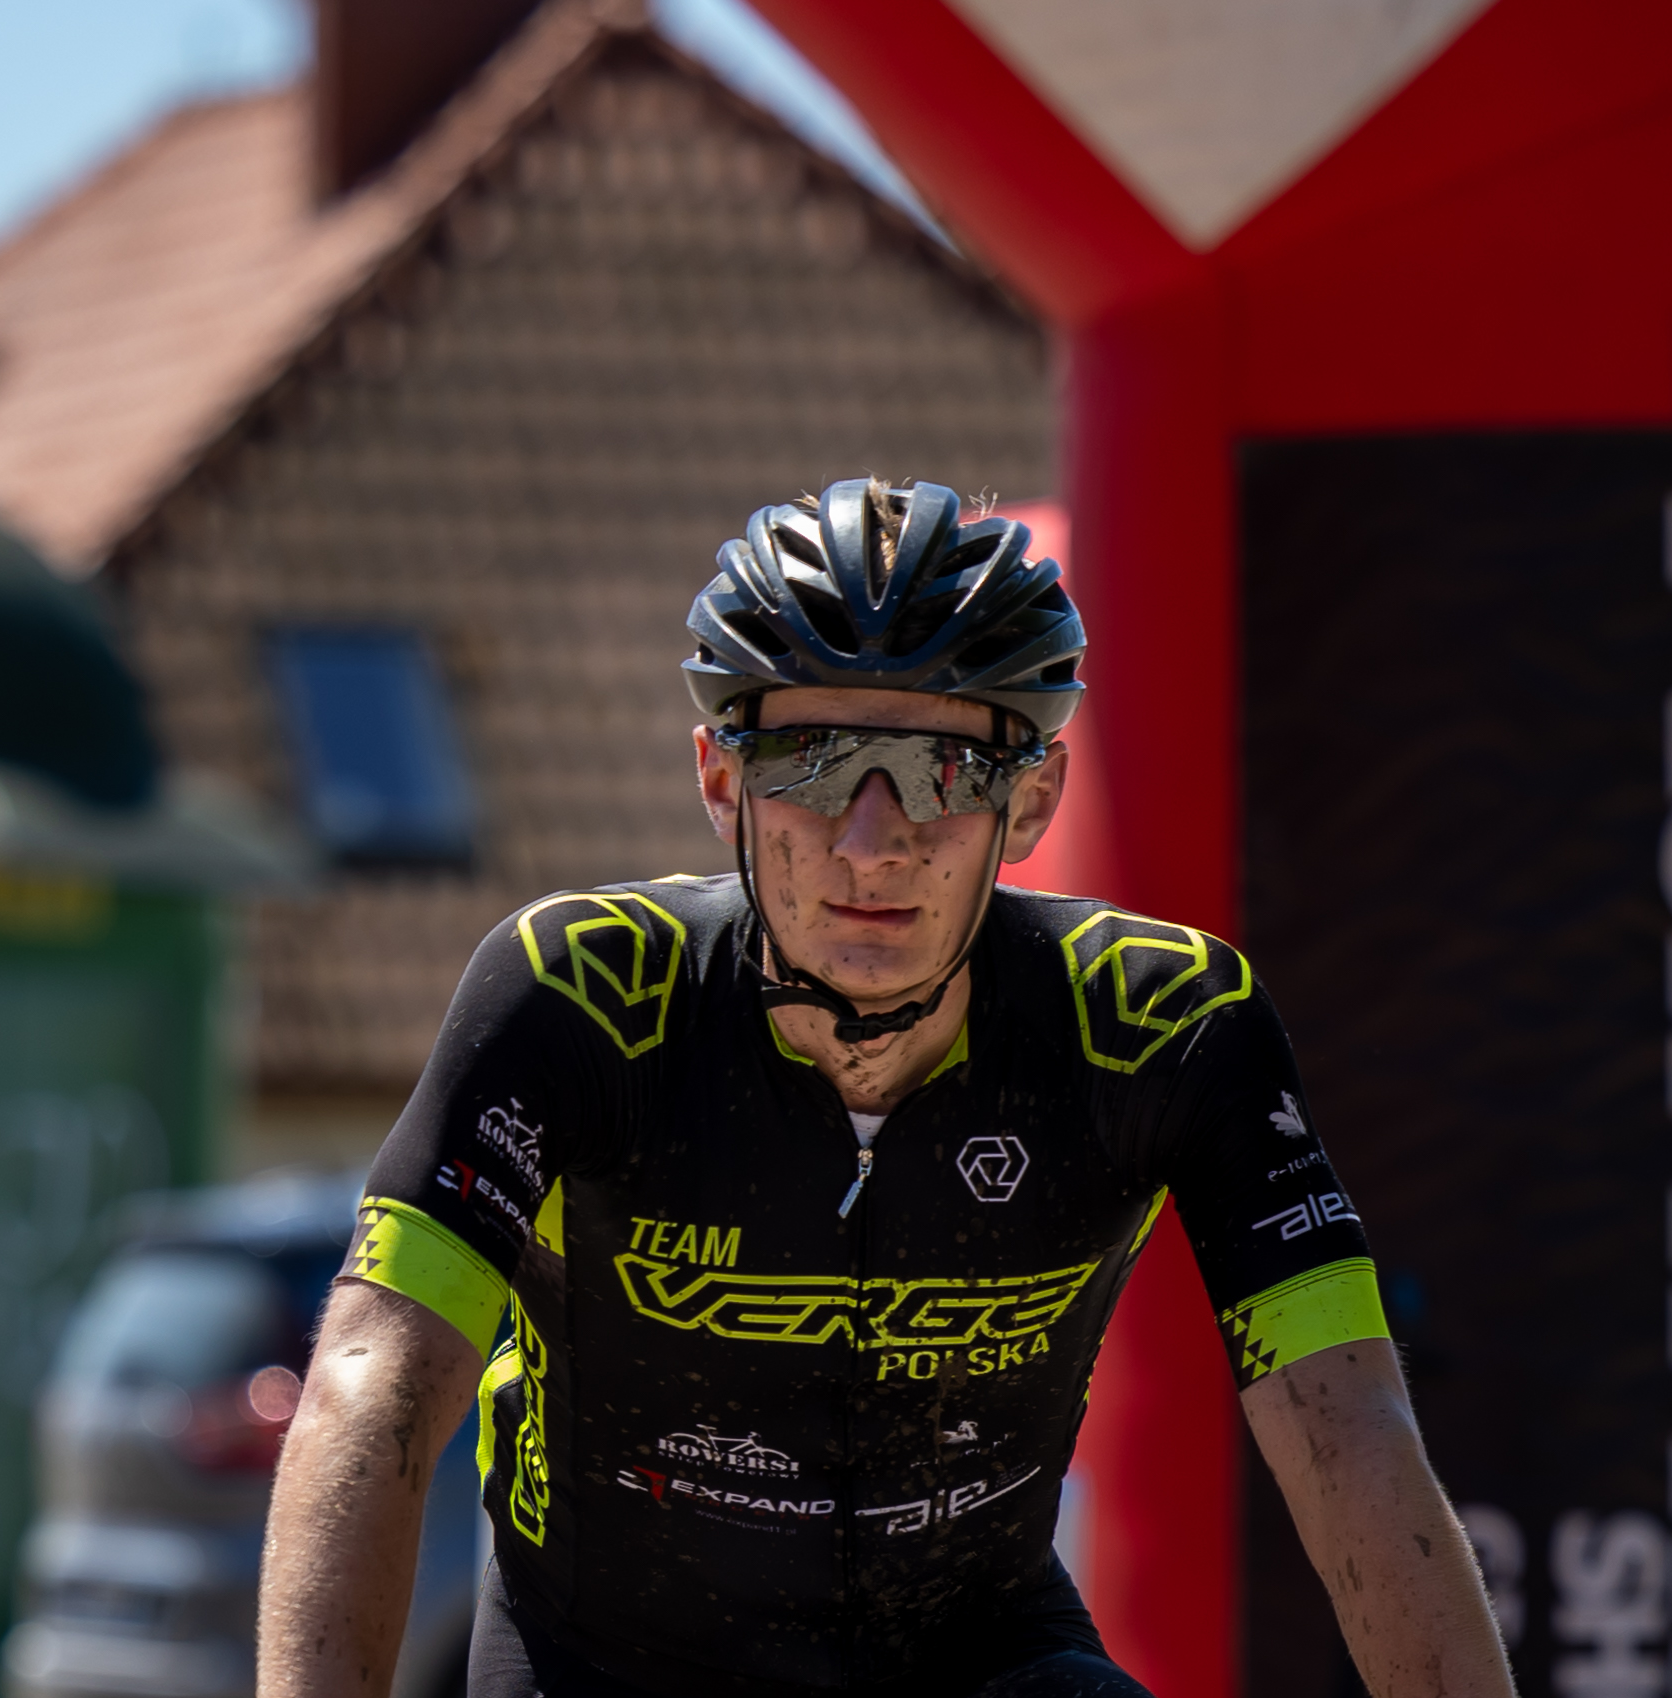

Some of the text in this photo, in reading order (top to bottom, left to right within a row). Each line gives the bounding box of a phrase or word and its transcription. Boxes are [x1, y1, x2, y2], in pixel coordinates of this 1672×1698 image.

[630, 1217, 741, 1267] TEAM
[614, 1252, 1104, 1351] VERGE
[876, 1331, 1050, 1382] POSKA
[658, 1438, 799, 1473] ROWERSI
[671, 1479, 835, 1515] EXPAND
